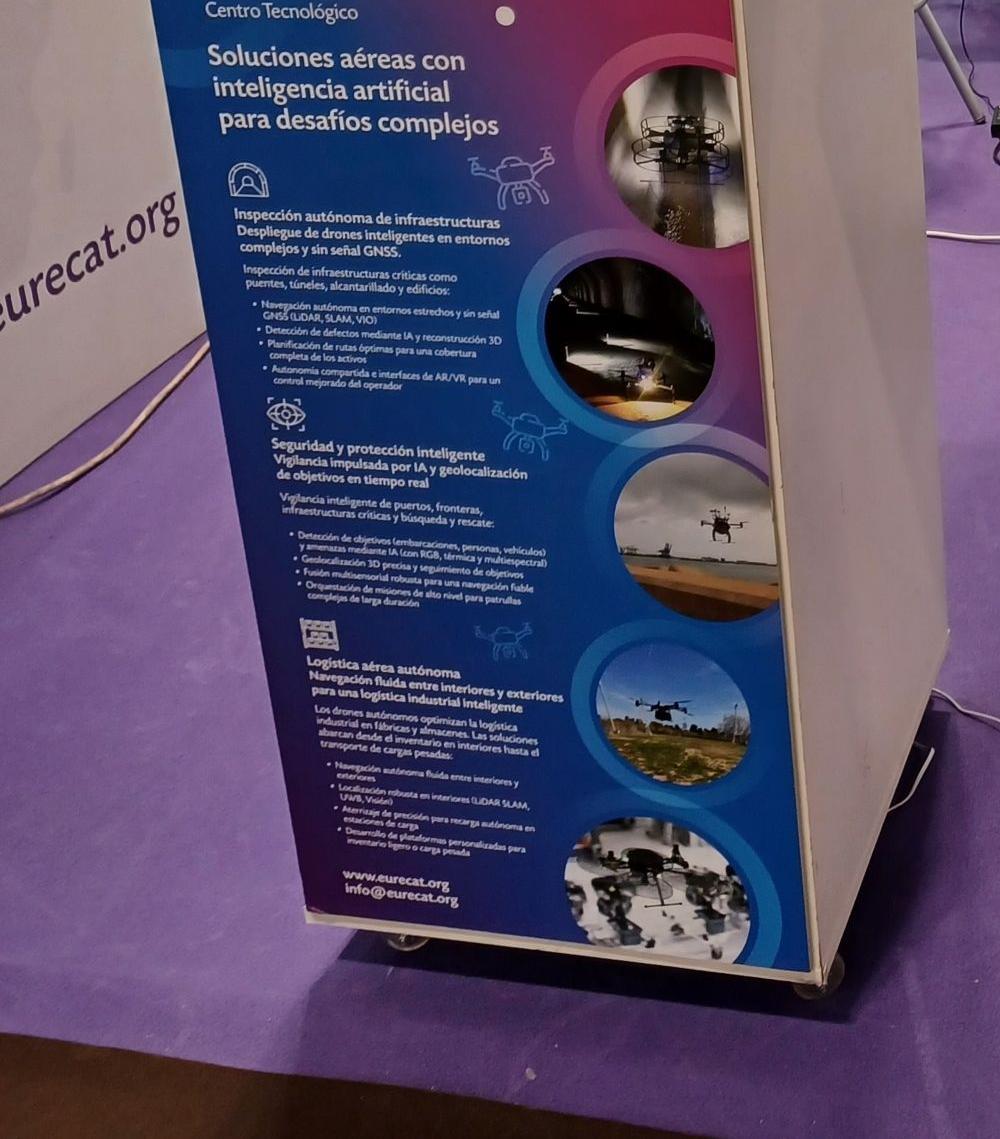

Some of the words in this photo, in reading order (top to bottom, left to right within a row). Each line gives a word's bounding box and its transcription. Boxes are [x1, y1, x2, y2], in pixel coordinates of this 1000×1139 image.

[205, 1, 261, 20] Centro
[261, 1, 358, 25] Tecnológico
[207, 44, 335, 69] Soluciones
[339, 46, 416, 71] aéreas
[421, 50, 466, 72] con
[212, 76, 348, 106] inteligencia
[353, 79, 451, 104] artificial
[218, 110, 271, 135] para
[276, 108, 373, 132] desafíos
[377, 112, 500, 142] complejos
[234, 206, 302, 224] Inspección
[304, 209, 372, 224] autónoma
[375, 211, 392, 225] de
[394, 212, 500, 229] infraestructuras
[237, 223, 302, 242] Despliegue
[303, 226, 319, 239] de
[321, 226, 362, 241] drones
[364, 228, 434, 246] inteligentes
[436, 234, 452, 244] en
[454, 233, 510, 246] entornos
[240, 240, 299, 257] complejos
[301, 245, 309, 258] y
[310, 241, 328, 255] sin
[330, 242, 361, 256] señal
[363, 243, 401, 257] GNSS.
[243, 262, 295, 278] Inspección
[296, 264, 310, 277] de
[311, 265, 390, 280] infraestructuras
[391, 268, 426, 281] críticas
[428, 273, 457, 282] como
[245, 279, 287, 293] puentes,
[289, 278, 328, 294] túneles,
[329, 279, 396, 293] alcantarillado
[397, 285, 404, 296] y
[405, 282, 450, 295] edificios:
[271, 436, 334, 455] Seguridad
[336, 444, 344, 457] y
[346, 443, 414, 458] protección
[416, 444, 485, 463] inteligente
[273, 451, 328, 469] Vigilancia
[330, 454, 388, 472] impulsada
[390, 462, 411, 475] por
[413, 459, 427, 473] IA
[429, 464, 436, 477] y
[438, 462, 528, 479] geolocalización
[276, 466, 291, 480] de
[292, 467, 345, 485] objetivos
[346, 474, 361, 485] en
[363, 472, 405, 491] tiempo
[407, 476, 430, 489] real
[279, 490, 325, 506] Vigilancia
[326, 493, 377, 510] inteligente
[378, 496, 391, 509] de
[282, 503, 355, 519] infraestructuras
[357, 508, 391, 521] críticas
[392, 513, 399, 525] y
[400, 510, 447, 526] búsqueda
[448, 516, 455, 528] y
[306, 654, 359, 672] Logística
[361, 659, 394, 674] aérea
[396, 663, 461, 679] autónoma
[309, 668, 373, 687] Navegación
[374, 674, 406, 689] fluida
[408, 680, 439, 692] entre
[440, 680, 495, 697] interiores
[496, 688, 504, 701] y
[506, 688, 564, 702] exteriores
[311, 687, 336, 699] para
[337, 689, 358, 699] una
[360, 687, 406, 704] logística
[407, 691, 460, 708] industrial
[462, 695, 523, 714] inteligente
[342, 871, 450, 893] www.eurecat.org
[345, 881, 459, 908] info@eurecat.org
